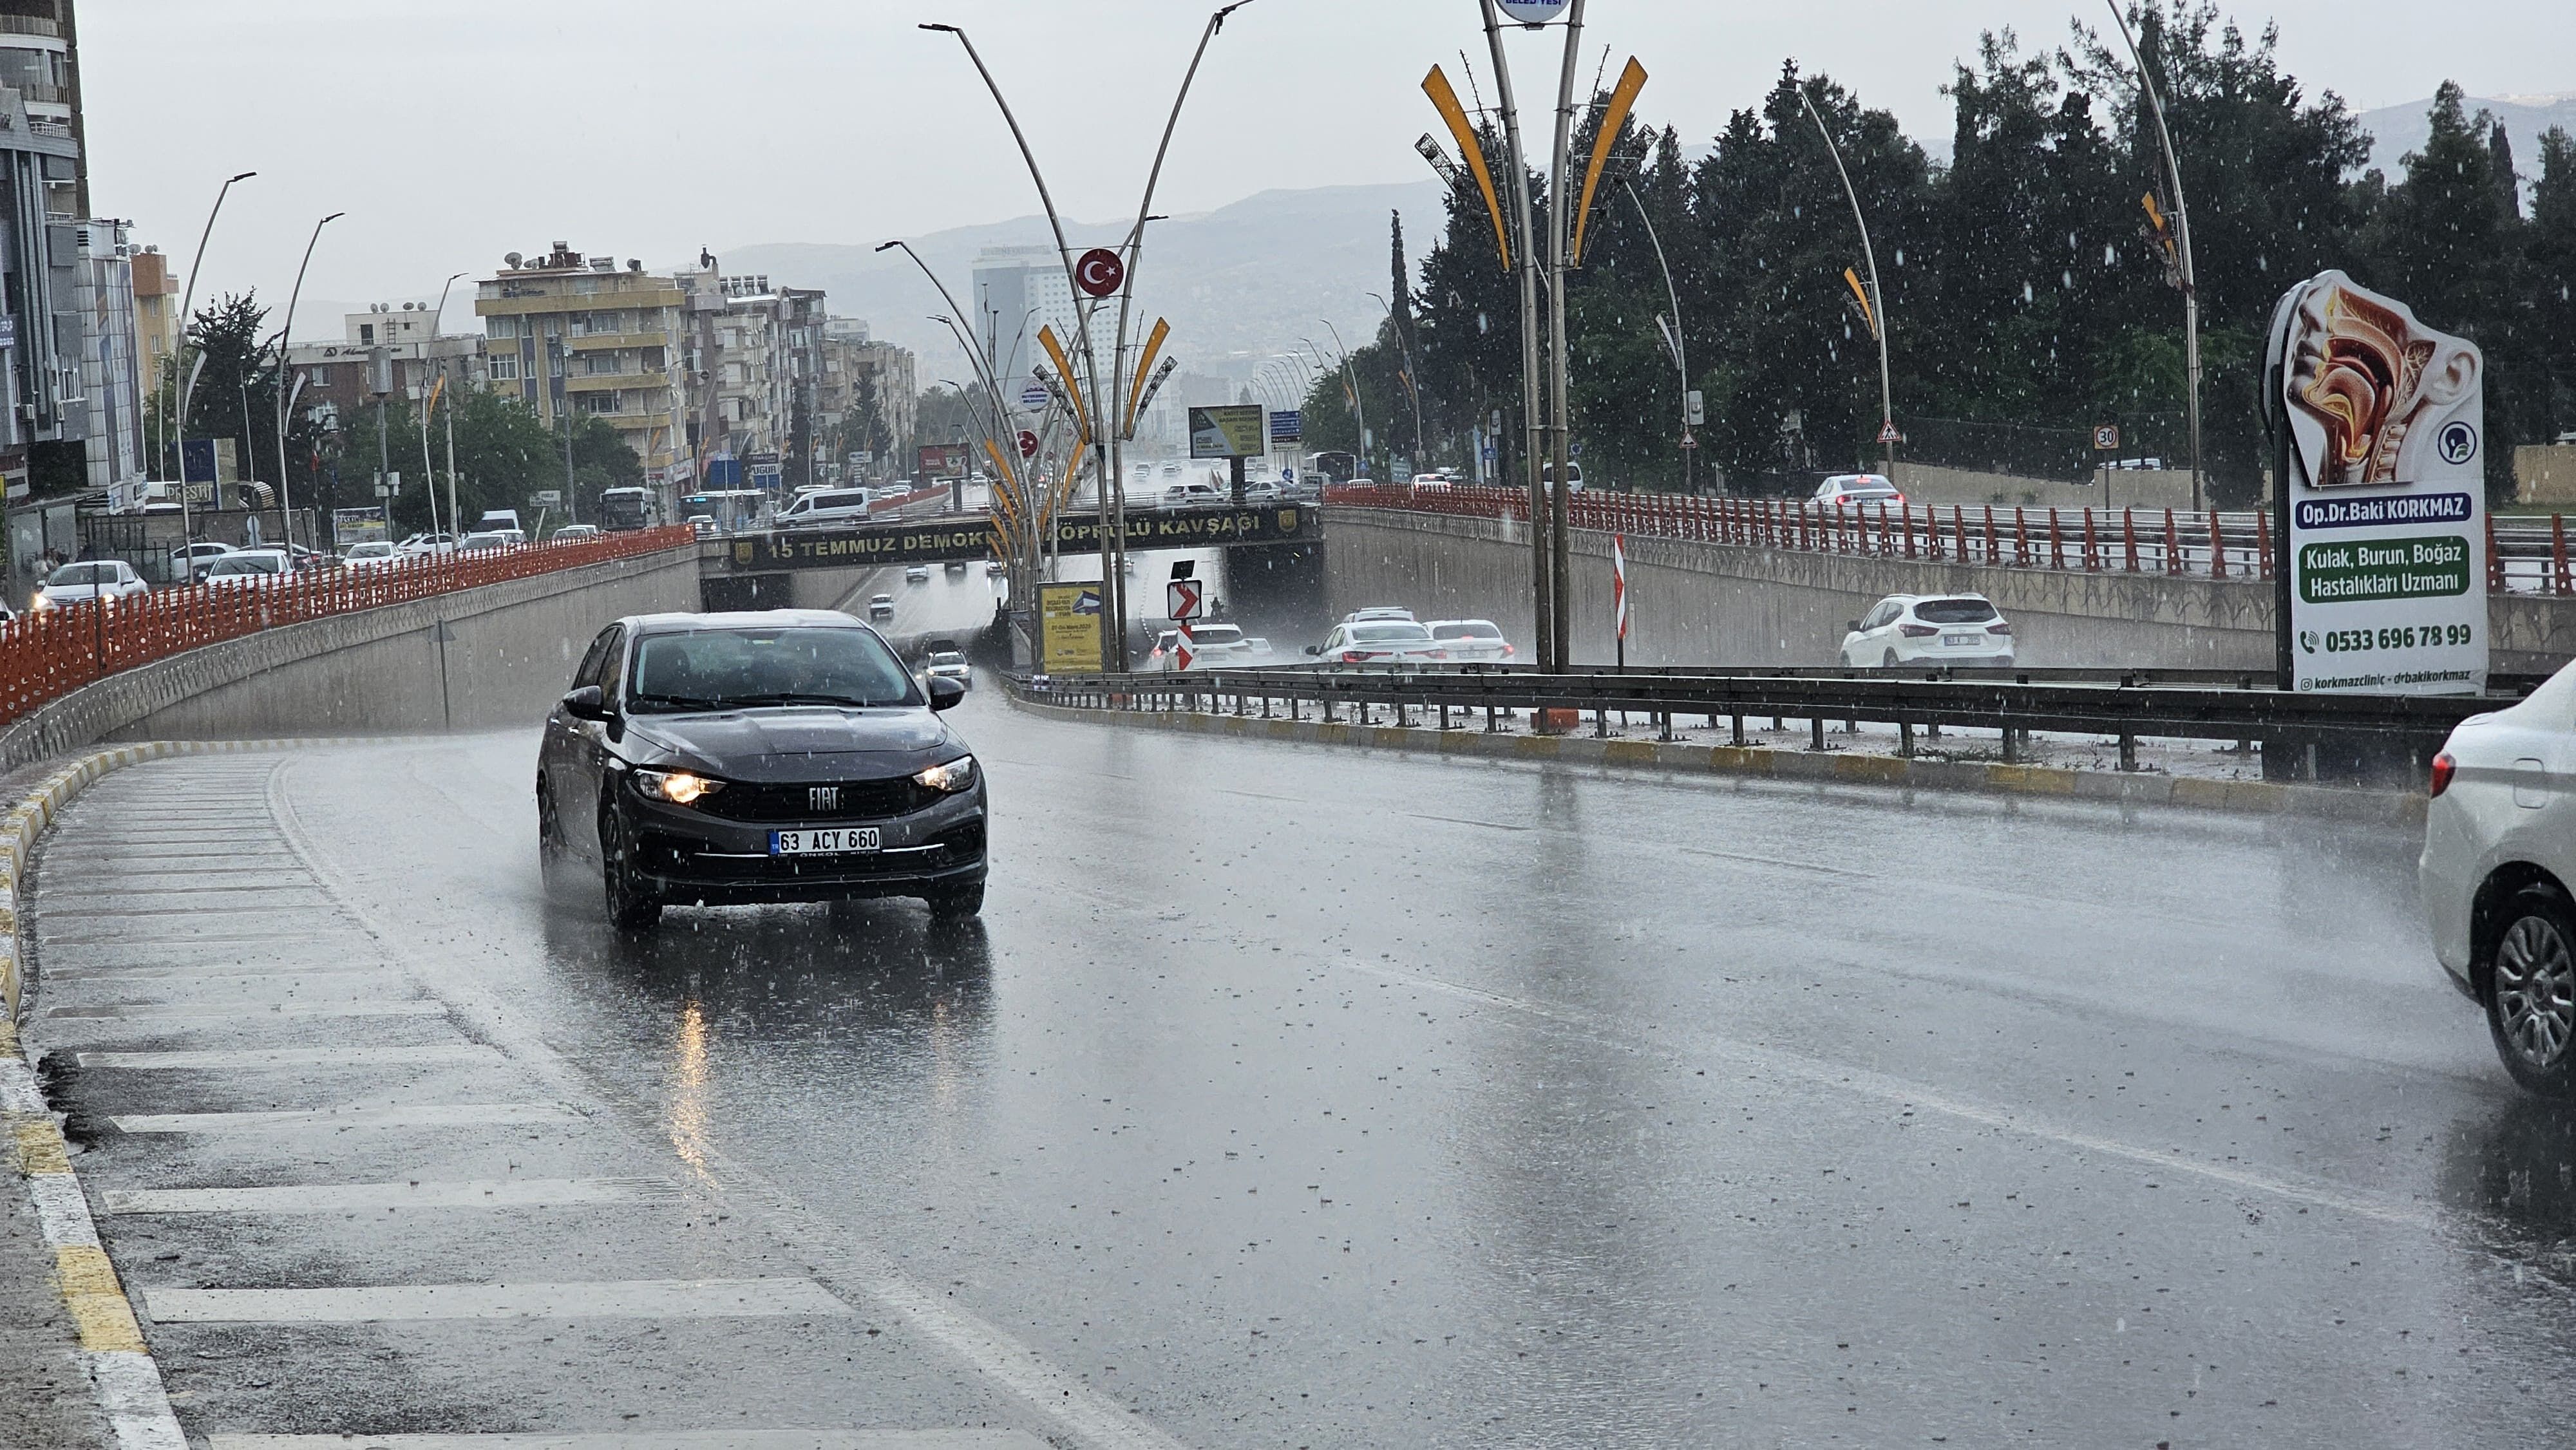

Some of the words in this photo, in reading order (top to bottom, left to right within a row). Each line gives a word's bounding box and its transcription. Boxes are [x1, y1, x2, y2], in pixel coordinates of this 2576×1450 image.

[2099, 431, 2113, 442] 30
[2387, 497, 2464, 518] KORKMAZ
[768, 543, 793, 558] 15
[800, 538, 896, 557] TEMMUZ
[904, 531, 1005, 550] DEMOKR
[1159, 512, 1260, 535] KAVŞAĞI
[2306, 549, 2354, 569] Kulak,
[2358, 547, 2409, 566] Burun,
[2413, 543, 2462, 565] Boğaz
[2311, 574, 2398, 597] Hastalıkları
[2401, 572, 2459, 592] Uzmanı
[2325, 630, 2374, 652] 0533
[2378, 627, 2416, 650] 696
[2419, 625, 2443, 646] 78
[2447, 624, 2472, 645] 99
[2315, 673, 2385, 690] korkmazclinic
[2394, 670, 2471, 684] drbakikorkmaz
[809, 787, 838, 811] FIAT
[781, 833, 799, 851] 63
[812, 831, 840, 850] ACY
[848, 830, 878, 848] 660
